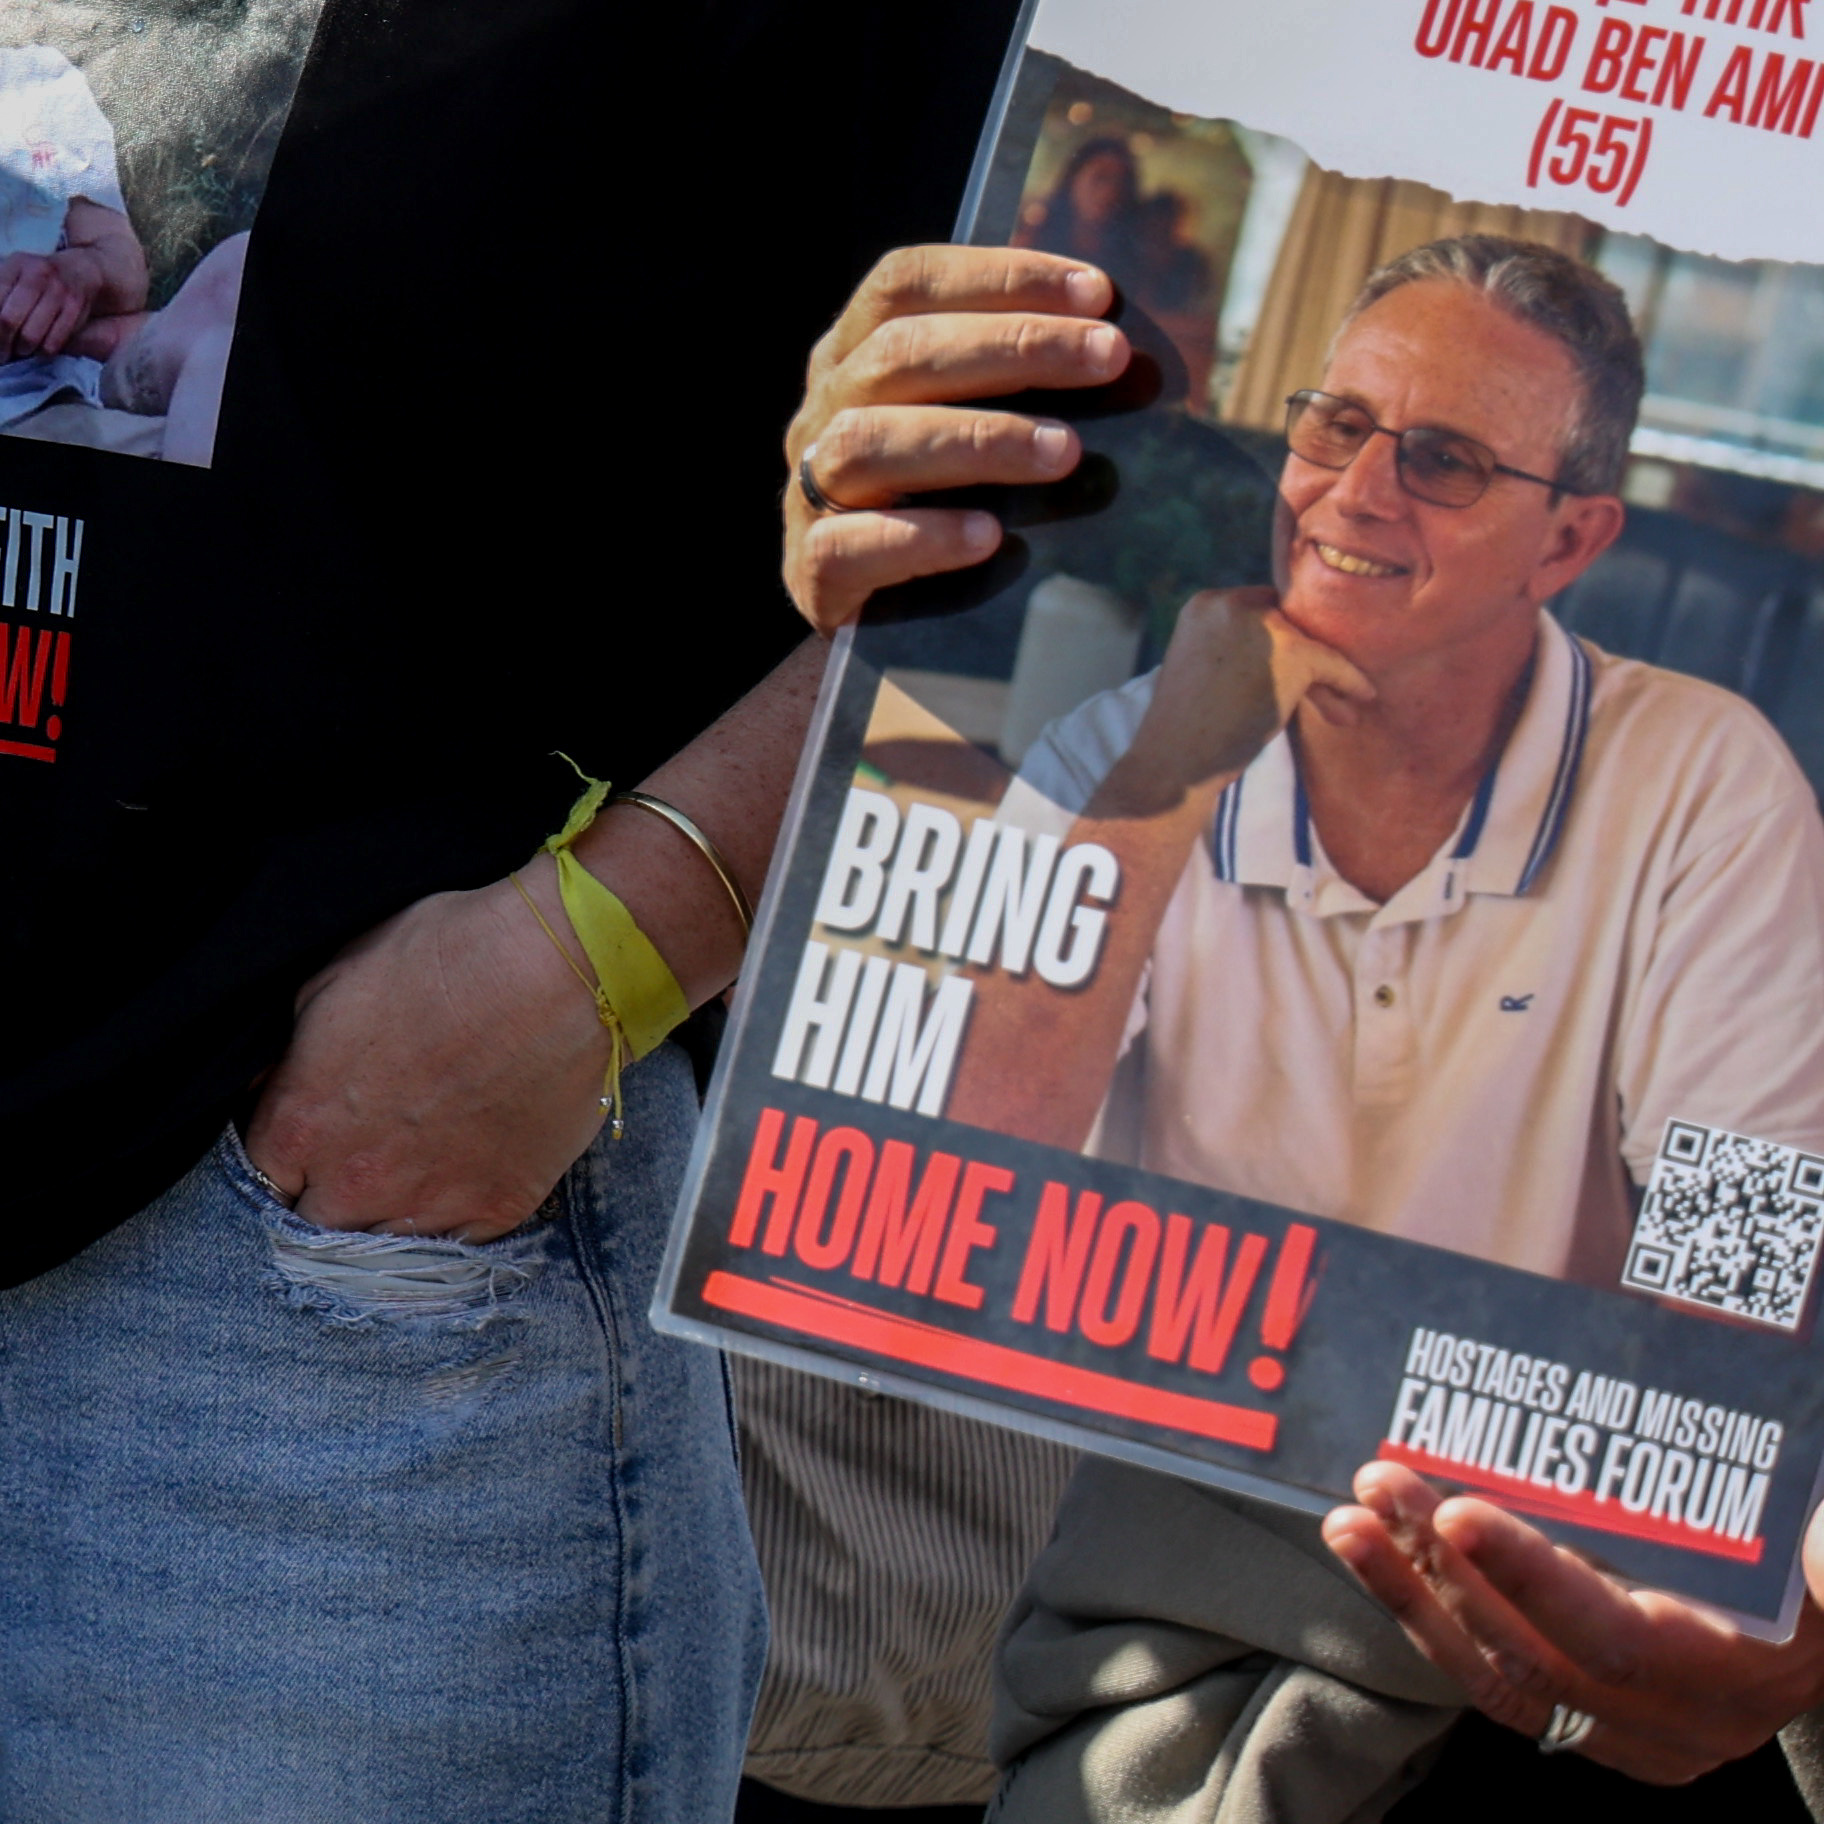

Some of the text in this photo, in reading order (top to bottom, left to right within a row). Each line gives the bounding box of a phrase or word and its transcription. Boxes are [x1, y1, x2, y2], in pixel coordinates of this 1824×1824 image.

[1526, 98, 1653, 207] (55)
[1581, 16, 1706, 111] BEN
[1702, 44, 1824, 139] AMI
[815, 788, 1120, 986] BRING
[771, 941, 975, 1117] HIM
[728, 1108, 1318, 1390] HOME NOW!
[1388, 1377, 1772, 1543] FAMILIES FORUM
[1405, 1327, 1784, 1470] HOSTAGES AND MISSING
